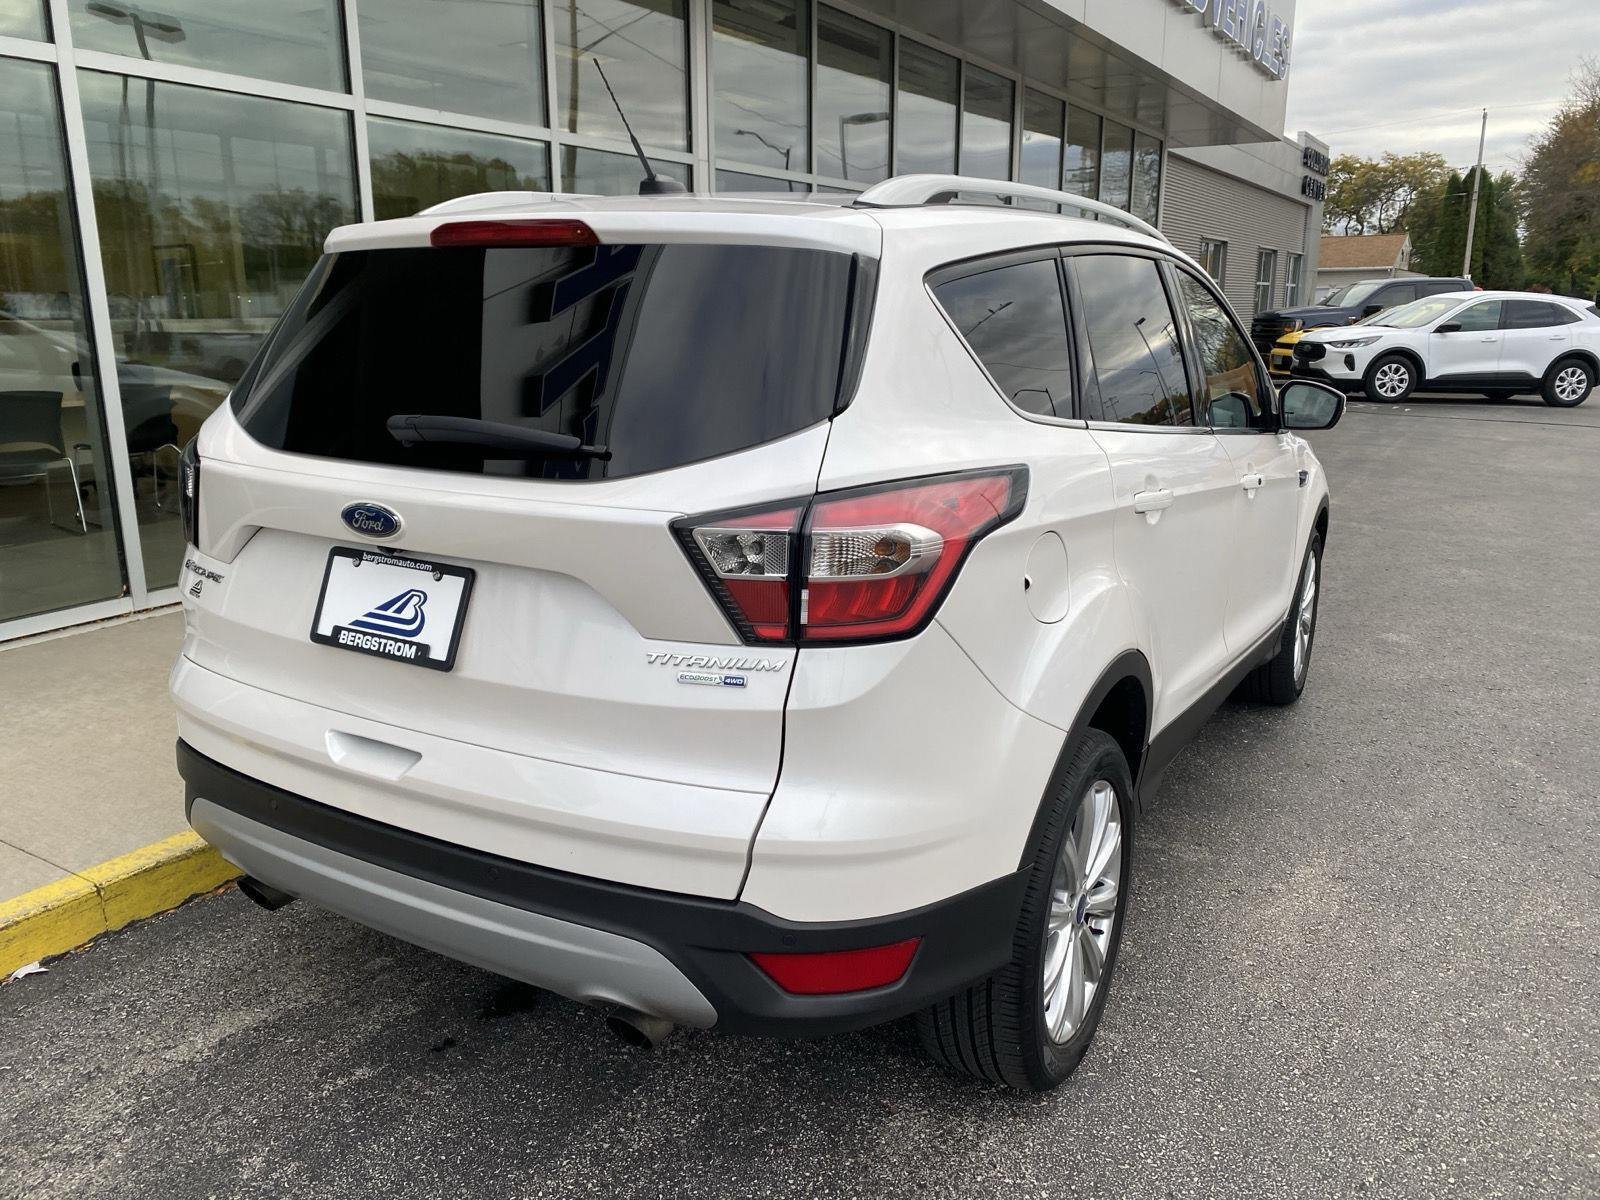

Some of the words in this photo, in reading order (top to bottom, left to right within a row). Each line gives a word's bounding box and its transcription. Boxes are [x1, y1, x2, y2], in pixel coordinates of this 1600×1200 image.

[352, 510, 384, 531] Ford
[362, 552, 433, 572] bergstromauto.com
[338, 630, 417, 659] BERGSTROM
[646, 652, 788, 672] TITANIUM
[725, 677, 744, 685] 4WD
